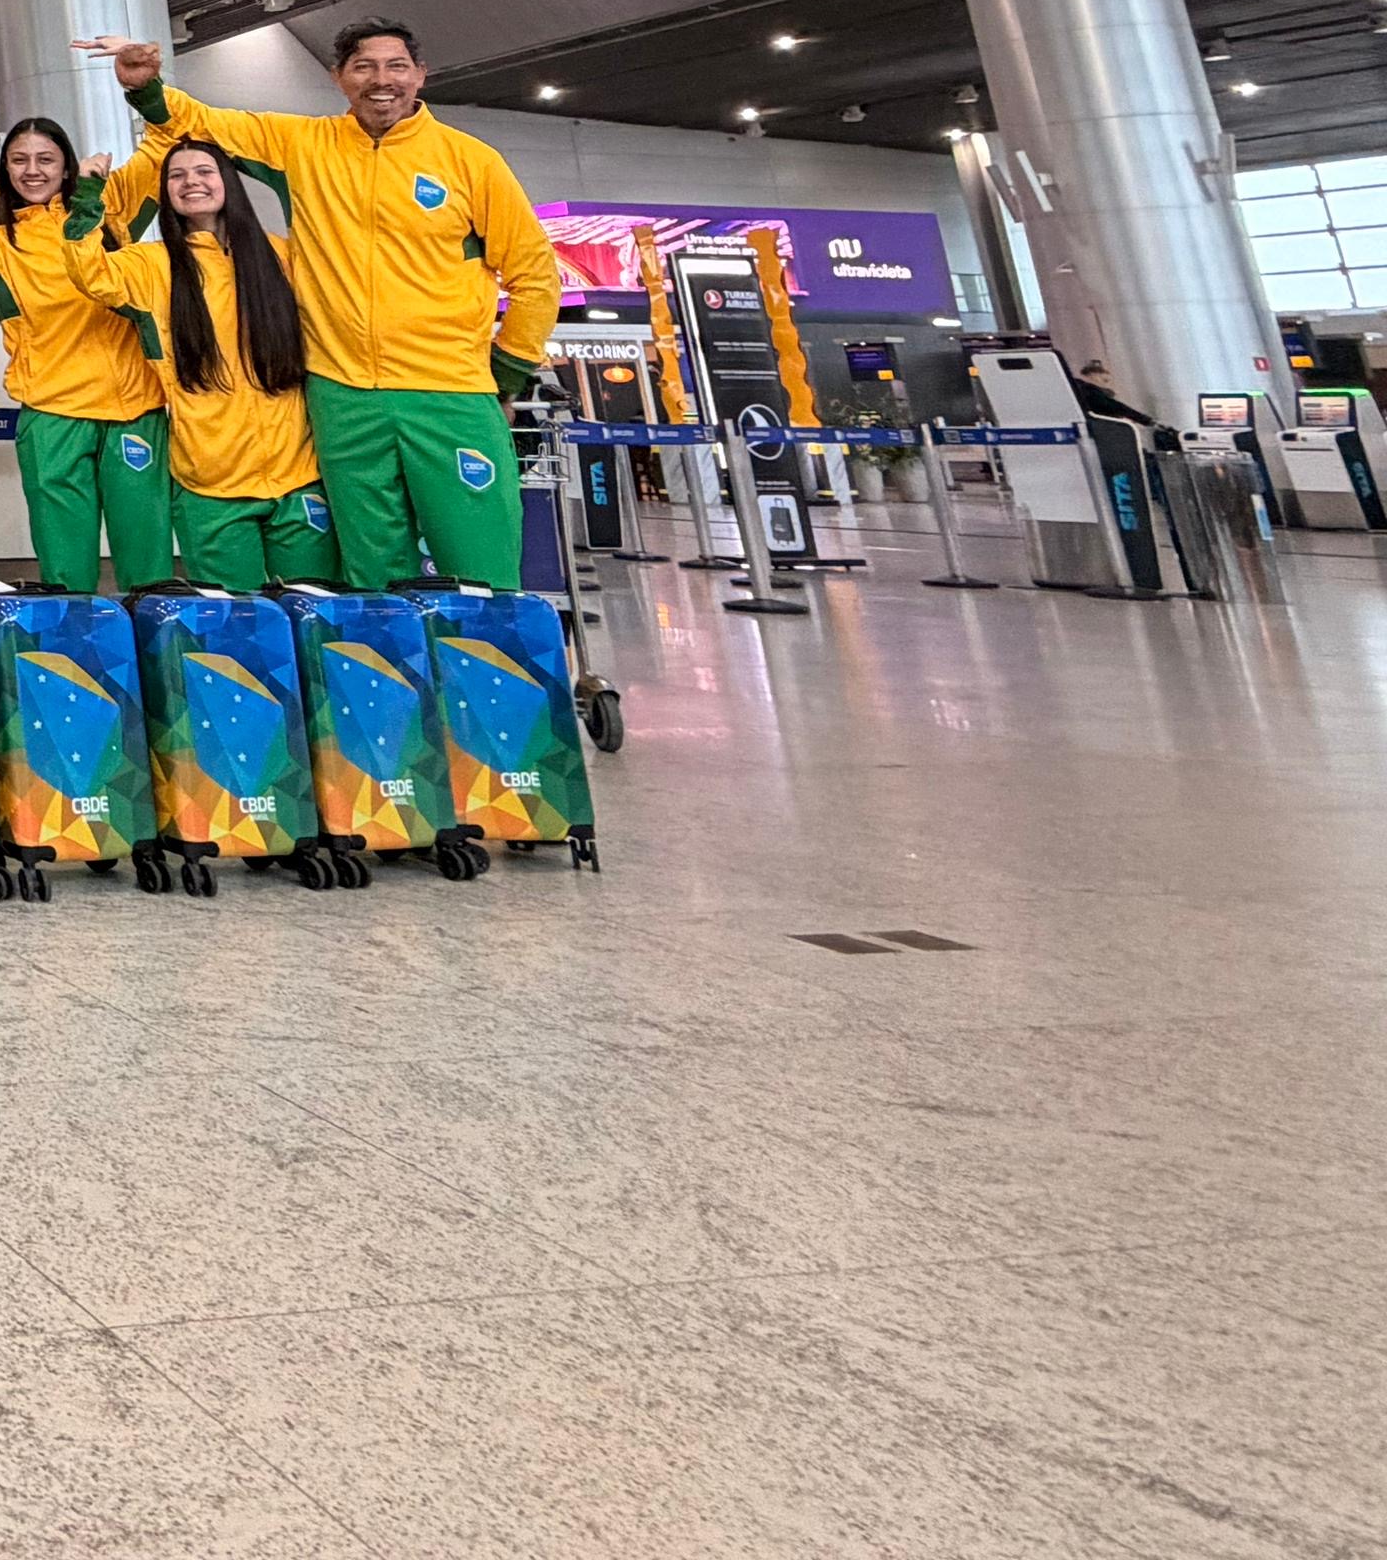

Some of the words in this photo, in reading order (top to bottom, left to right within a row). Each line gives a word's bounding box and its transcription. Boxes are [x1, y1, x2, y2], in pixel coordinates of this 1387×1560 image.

[828, 238, 862, 258] nu
[832, 262, 912, 279] ultravioleta
[565, 343, 641, 360] PECORINO
[589, 460, 608, 506] SITA
[379, 778, 415, 798] CBDE
[500, 771, 541, 788] CBDE
[71, 795, 109, 814] CBDE
[238, 795, 277, 814] CBDE
